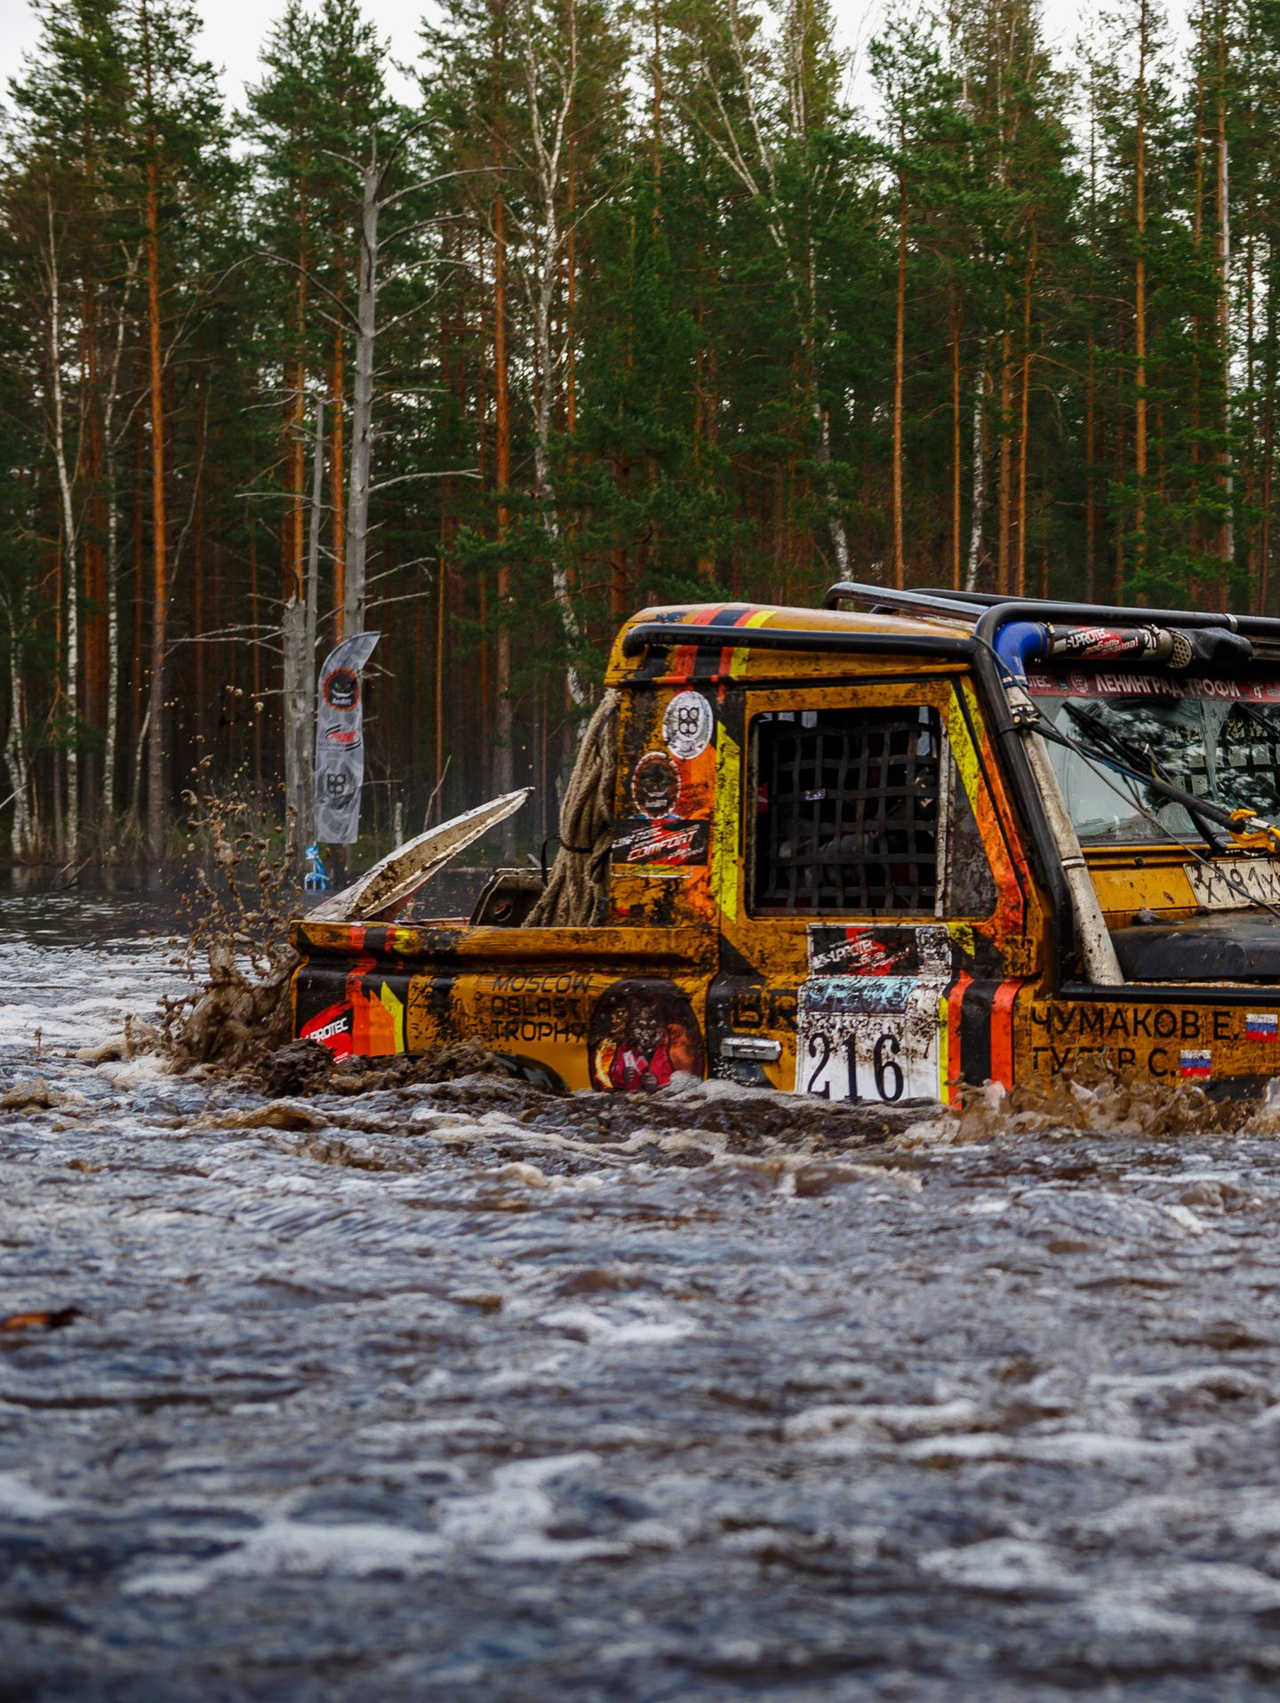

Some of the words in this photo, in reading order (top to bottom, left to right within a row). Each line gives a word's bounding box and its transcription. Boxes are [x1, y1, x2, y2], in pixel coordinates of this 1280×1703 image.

[1066, 628, 1111, 648] SUPROTEC
[627, 829, 698, 861] COMFORT
[492, 974, 593, 993] MOSCOW
[491, 995, 581, 1018] OBLAST
[301, 1016, 349, 1043] PROTEC
[491, 1019, 586, 1043] TROPHY
[1031, 1006, 1200, 1039] ЧУМАКОВ
[1213, 1011, 1240, 1041] Е.
[807, 1032, 904, 1101] 216
[1033, 1047, 1137, 1075] ГУВ
[1147, 1049, 1177, 1078] С.
